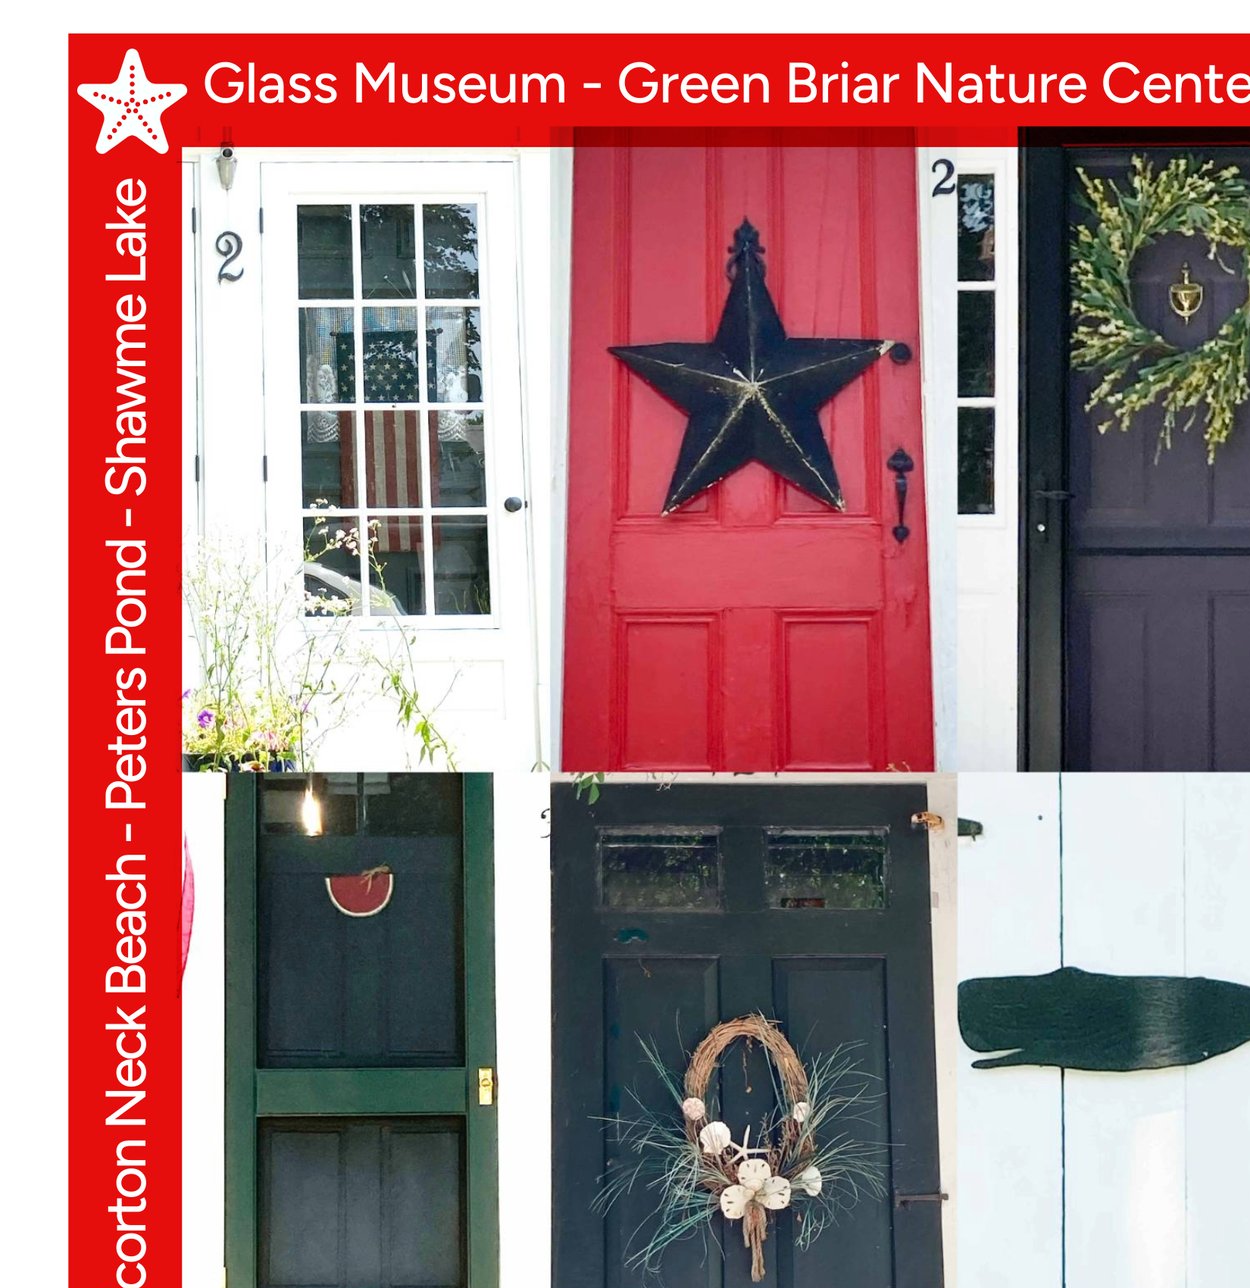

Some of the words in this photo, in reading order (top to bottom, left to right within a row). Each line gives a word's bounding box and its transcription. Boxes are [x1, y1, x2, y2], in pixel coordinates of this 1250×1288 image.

[204, 61, 338, 104] Glass
[355, 62, 565, 104] Museum
[618, 61, 770, 104] Green
[788, 61, 900, 104] Briar
[916, 62, 1087, 104] Nature
[105, 178, 147, 281] Lake
[932, 158, 957, 198] 2
[215, 231, 244, 283] 2
[104, 294, 147, 497] Shawme
[105, 539, 147, 655] Pond
[105, 667, 147, 809] Peters
[105, 854, 147, 993] Beach
[105, 1004, 147, 1126] Neck
